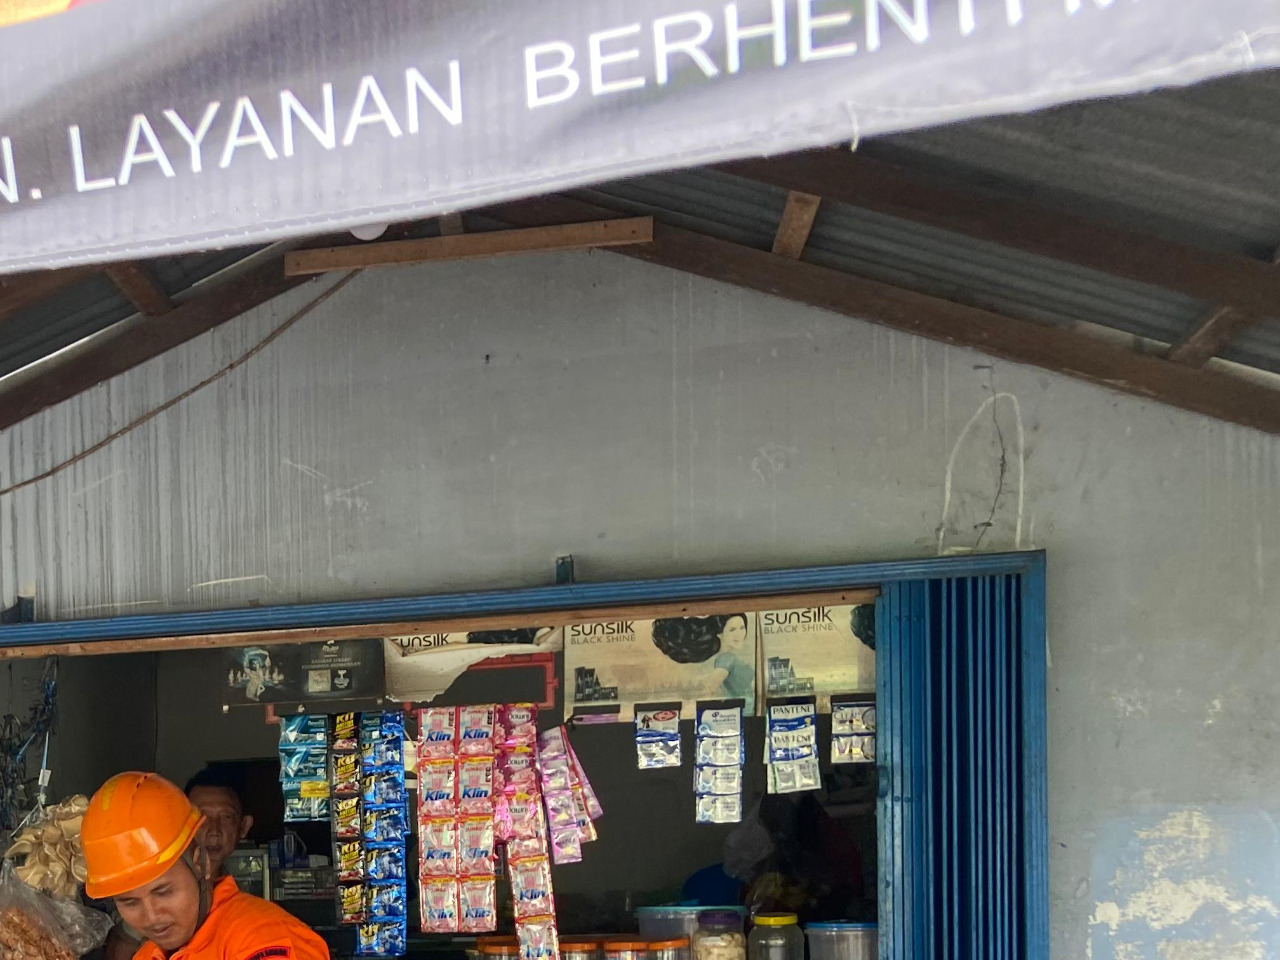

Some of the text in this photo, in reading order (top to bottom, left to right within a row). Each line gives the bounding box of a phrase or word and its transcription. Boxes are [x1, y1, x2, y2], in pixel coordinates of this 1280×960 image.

[67, 60, 464, 193] LAYANAN
[764, 621, 834, 635] BLACK SHINE
[390, 633, 450, 648] unsilk
[570, 633, 636, 645] BLACK SHINE
[772, 706, 811, 715] PANTENE
[426, 730, 452, 742] Klin
[462, 728, 490, 740] Klin
[424, 790, 451, 802] Klin
[462, 787, 489, 799] Klin
